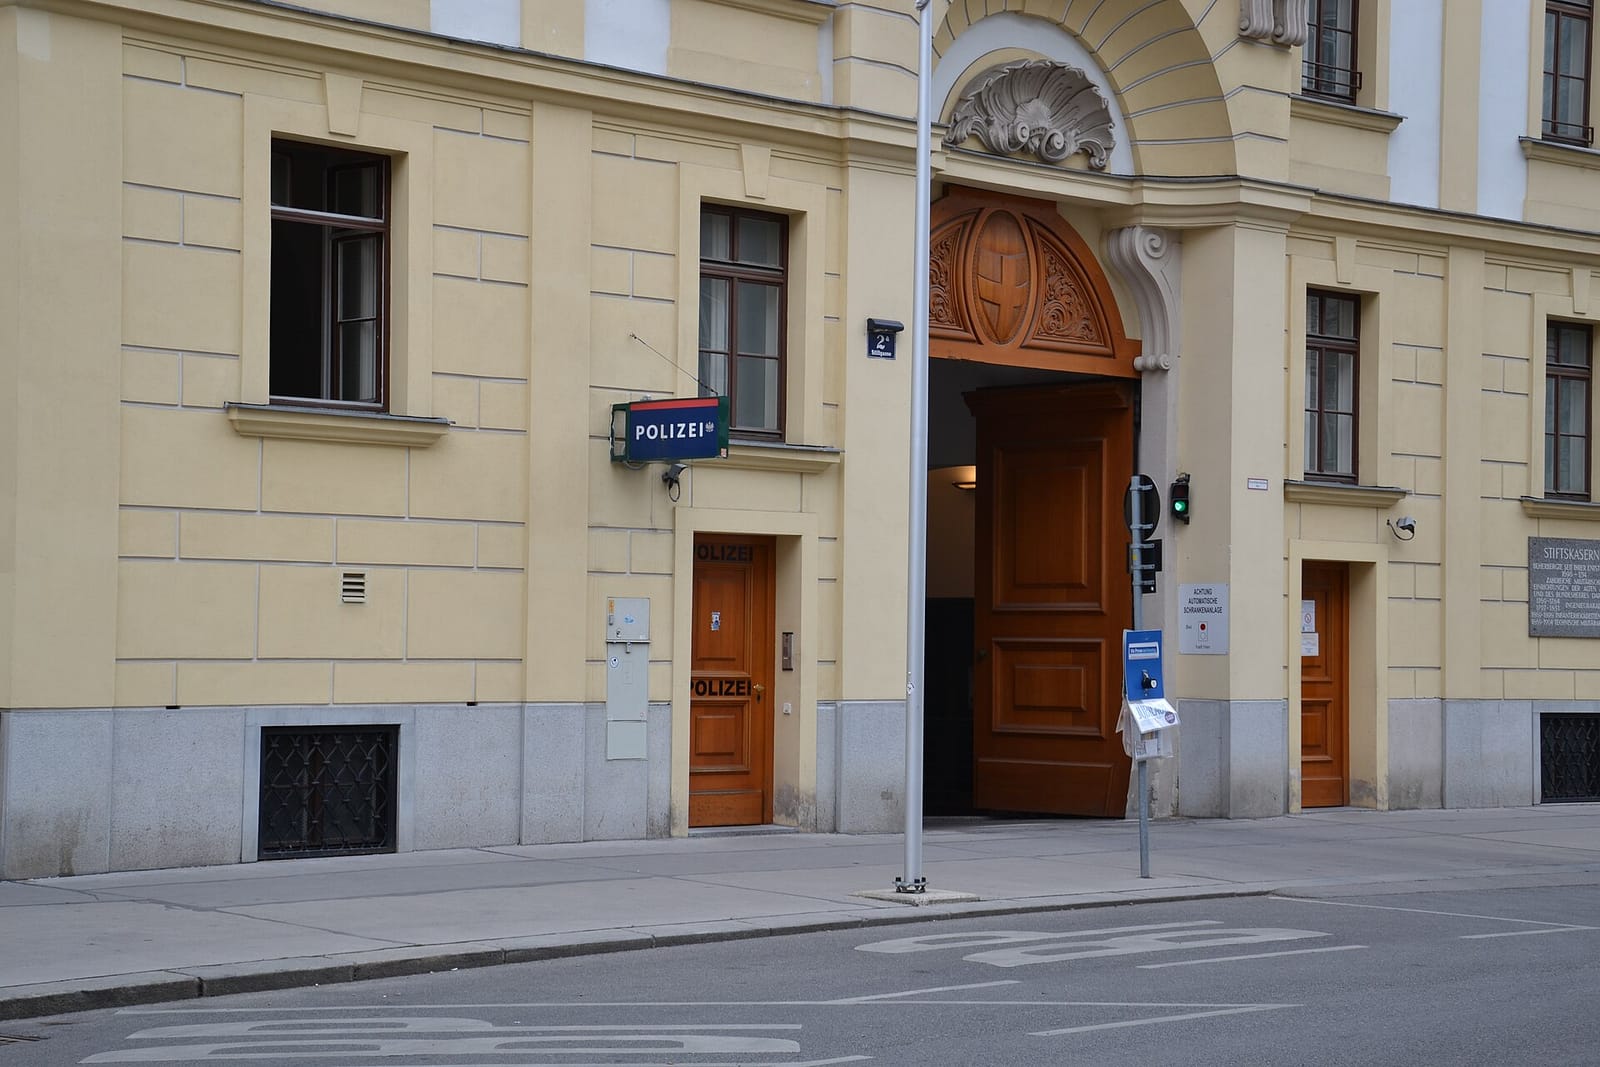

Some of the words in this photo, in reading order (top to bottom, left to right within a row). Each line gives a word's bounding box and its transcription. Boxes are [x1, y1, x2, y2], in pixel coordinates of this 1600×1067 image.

[635, 421, 704, 441] POLIZEI
[693, 543, 753, 561] OLIZEI
[1183, 606, 1223, 614] SCHRANKENANLAGE
